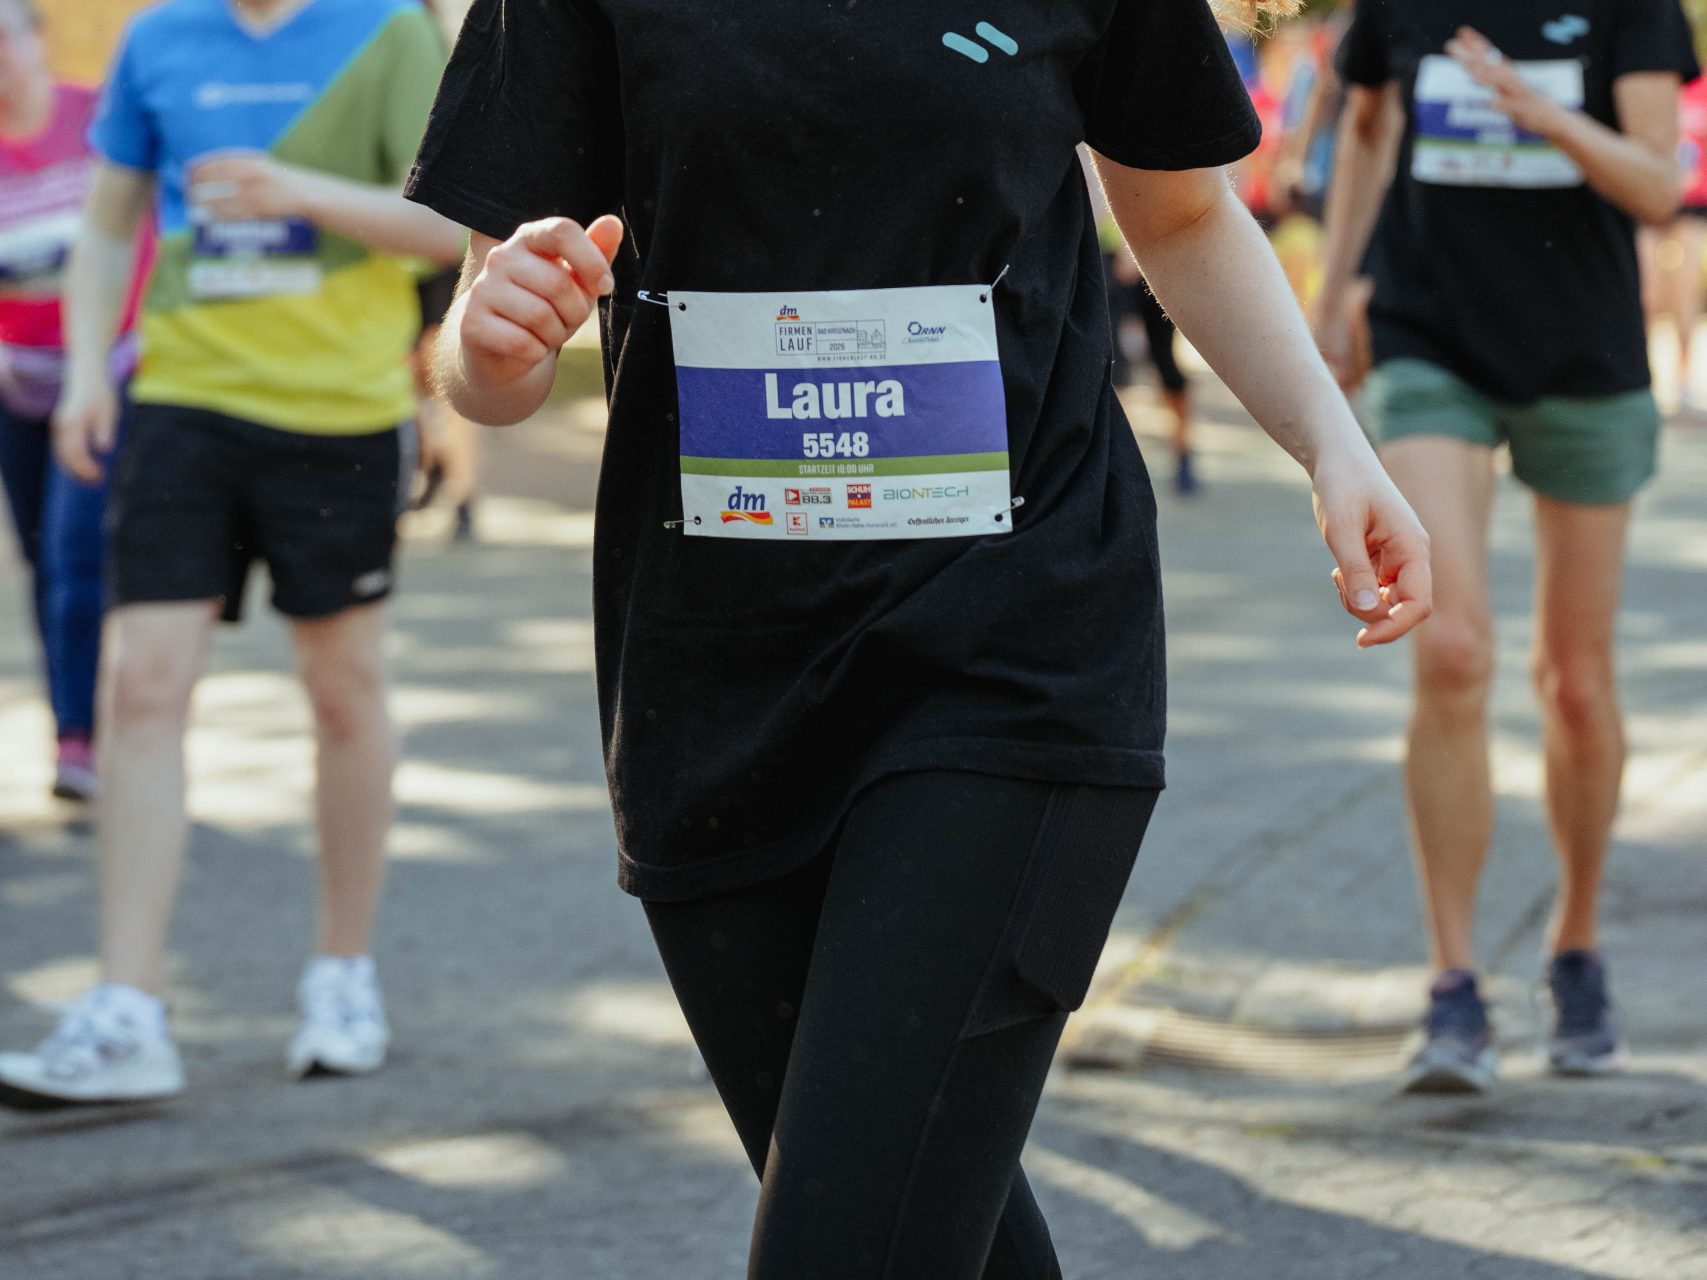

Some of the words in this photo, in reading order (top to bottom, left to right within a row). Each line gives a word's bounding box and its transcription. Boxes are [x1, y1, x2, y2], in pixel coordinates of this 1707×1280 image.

[780, 305, 797, 315] dm
[780, 327, 812, 336] FIRMEN
[780, 338, 812, 351] LAUF
[764, 372, 905, 420] Laura
[803, 431, 870, 458] 5548
[799, 464, 836, 475] STARTZEIT
[858, 463, 874, 473] UHR
[847, 485, 871, 494] SCHUH
[883, 485, 969, 500] BIONTECH
[727, 485, 766, 511] dm
[802, 495, 831, 504] 88.3
